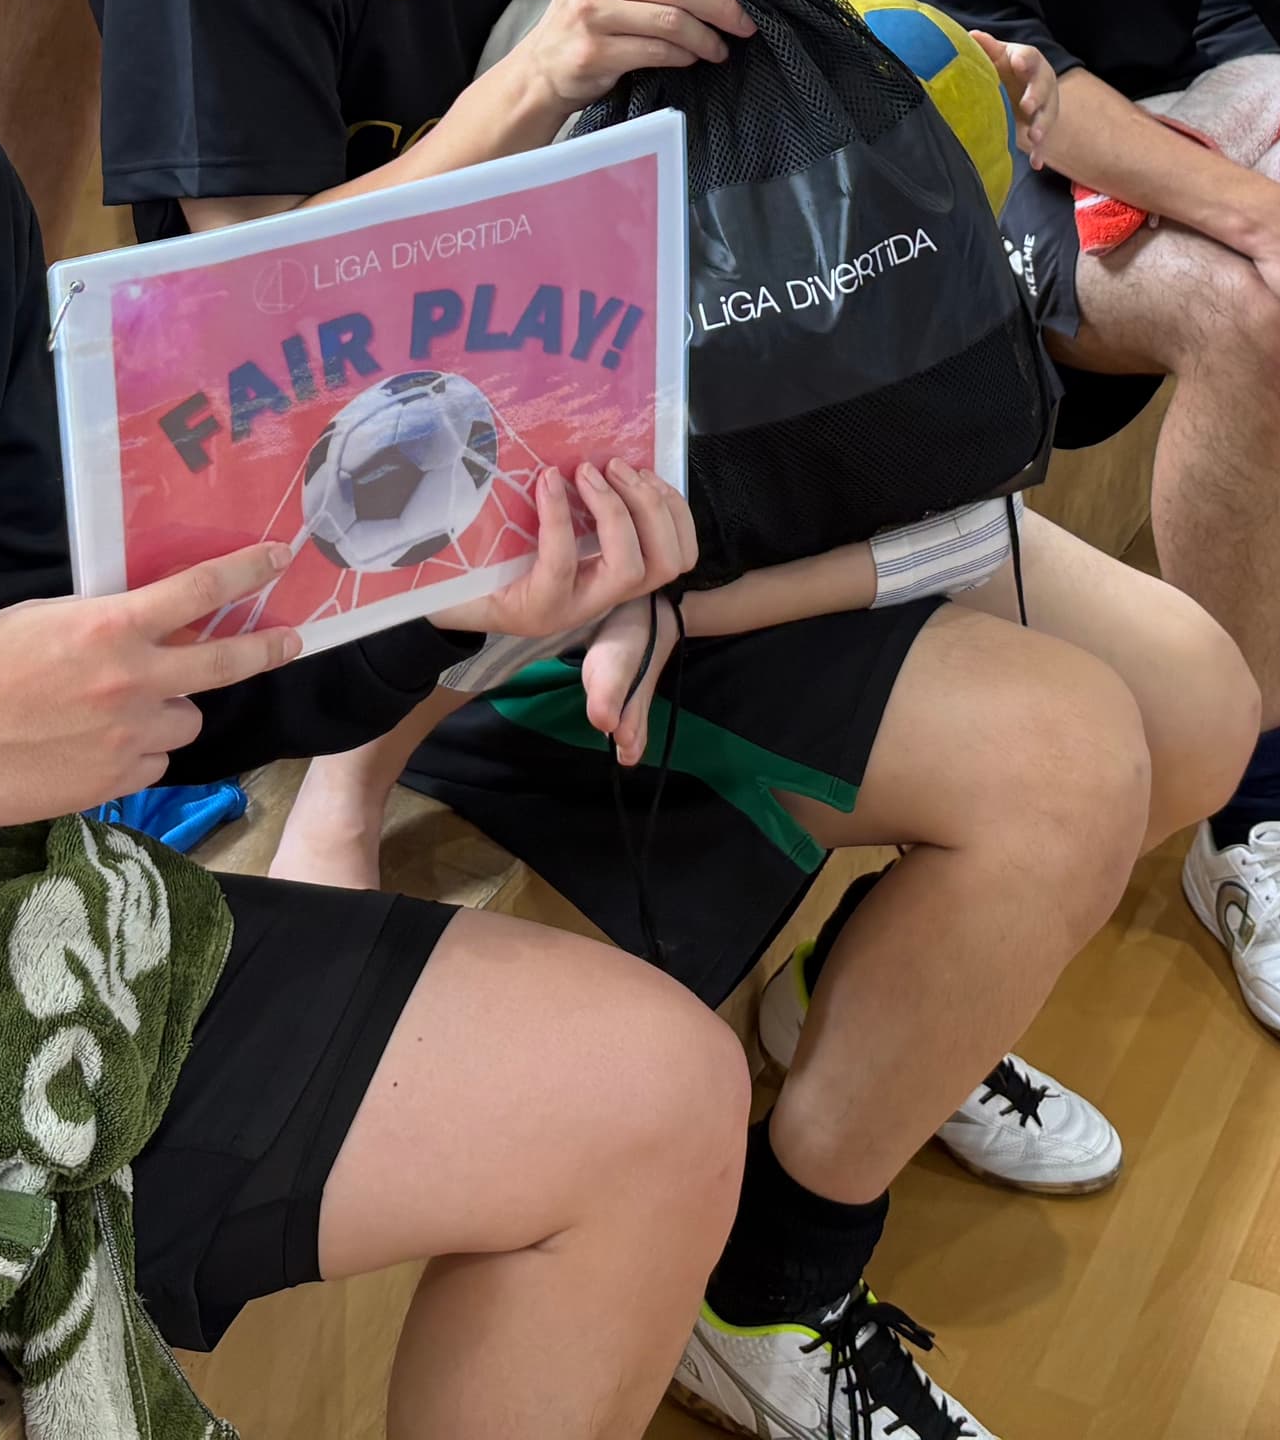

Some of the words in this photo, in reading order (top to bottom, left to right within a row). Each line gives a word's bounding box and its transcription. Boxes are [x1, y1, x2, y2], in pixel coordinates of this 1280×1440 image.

[1023, 233, 1038, 297] KELME
[157, 311, 383, 474] FAIR
[409, 283, 645, 371] PLAY!
